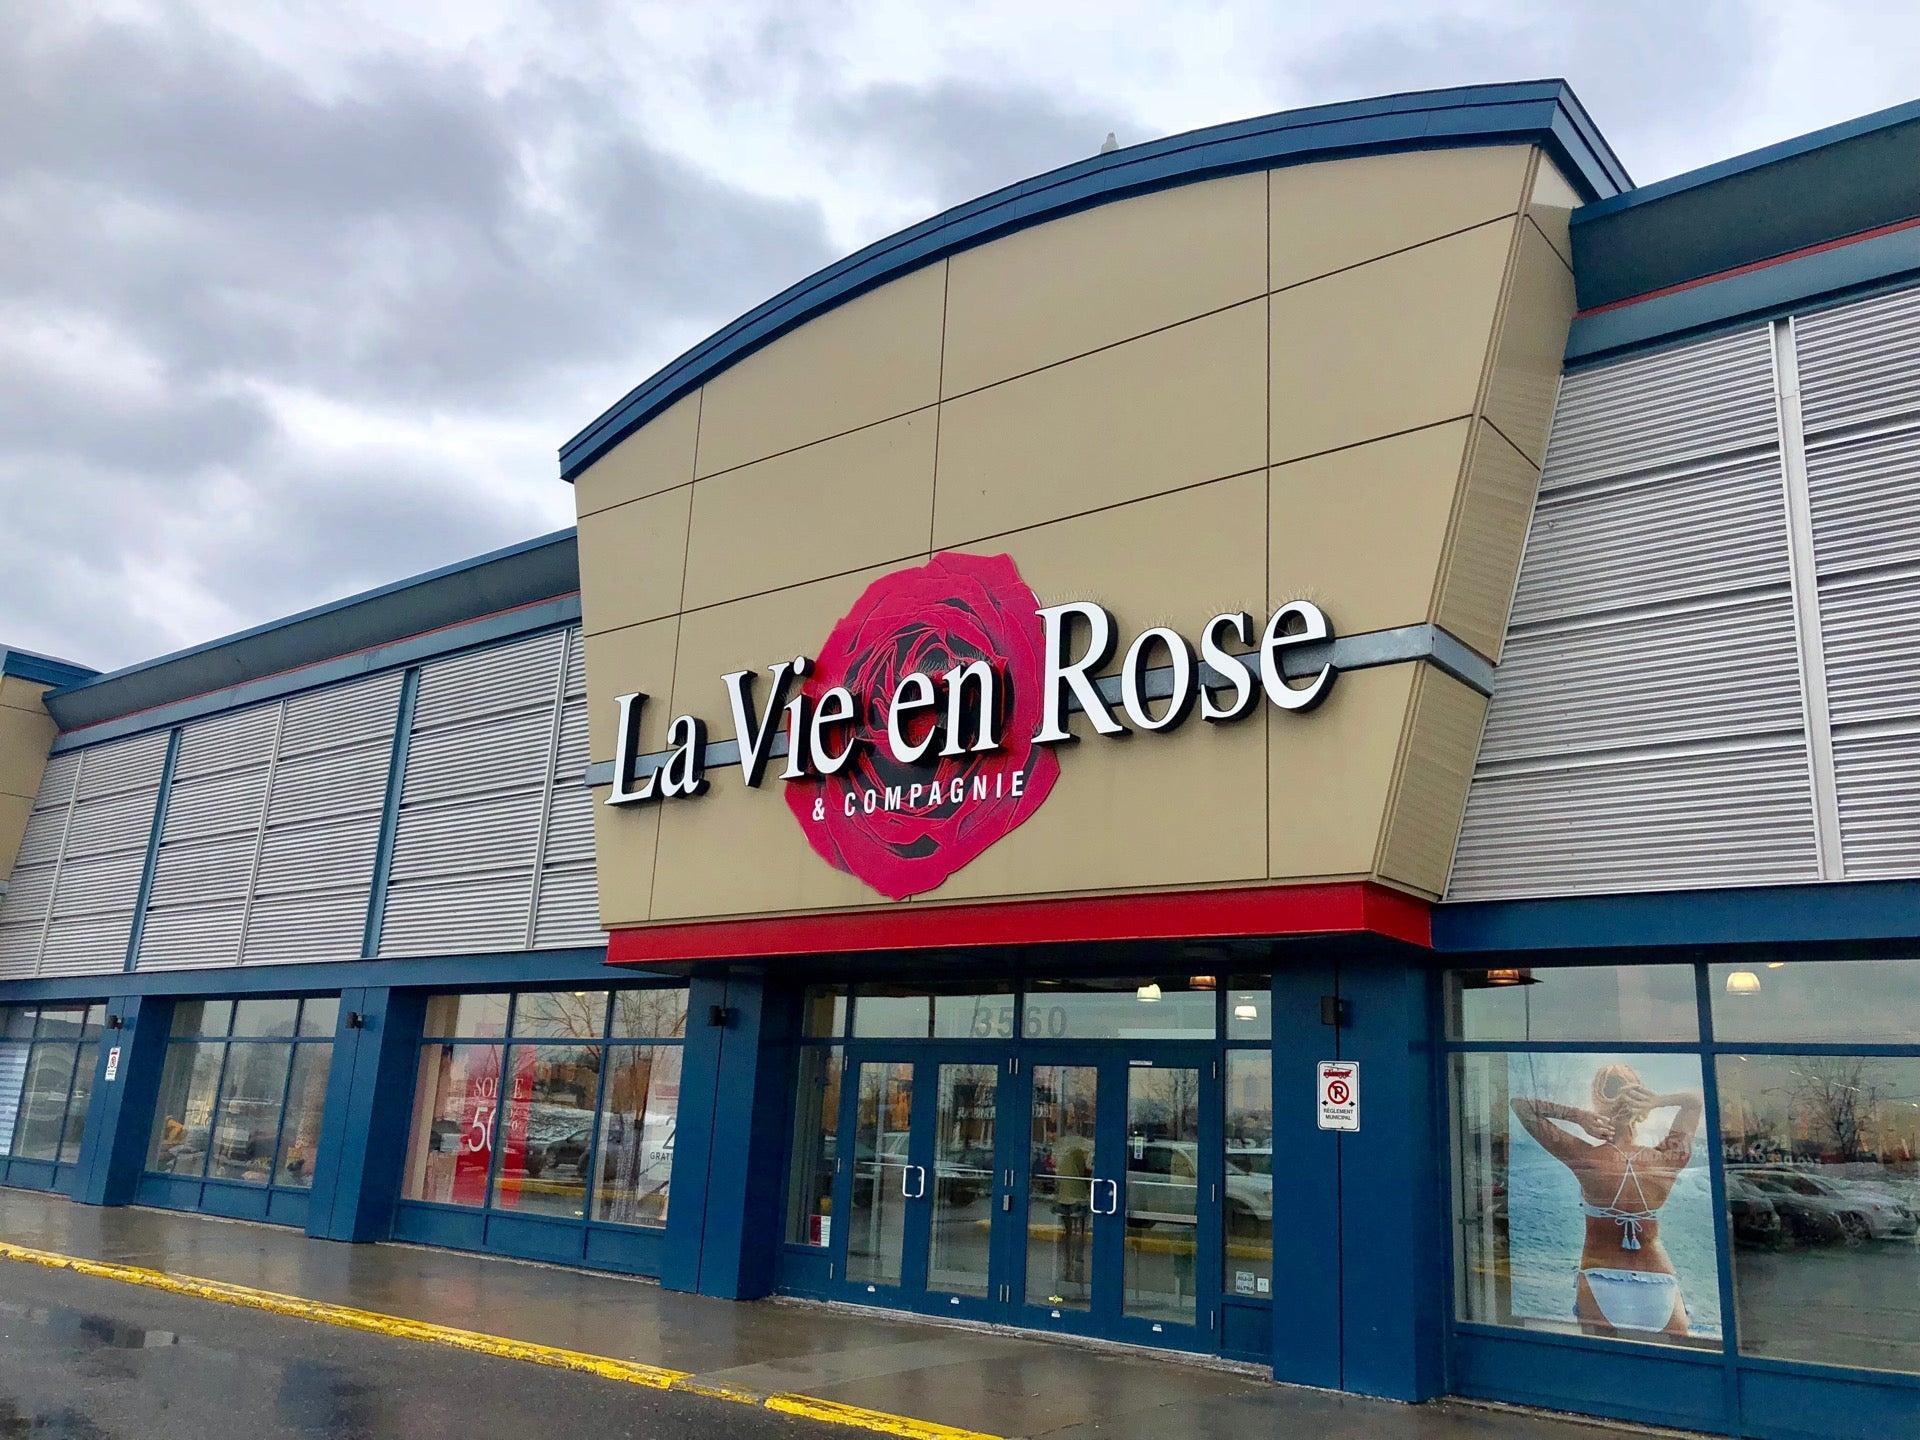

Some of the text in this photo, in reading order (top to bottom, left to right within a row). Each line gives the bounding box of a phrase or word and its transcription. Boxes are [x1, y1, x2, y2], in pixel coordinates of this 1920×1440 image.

[606, 599, 1332, 805] La Vie en Rose
[812, 770, 1024, 821] & COMPAGNIE
[975, 1006, 1067, 1038] 3560
